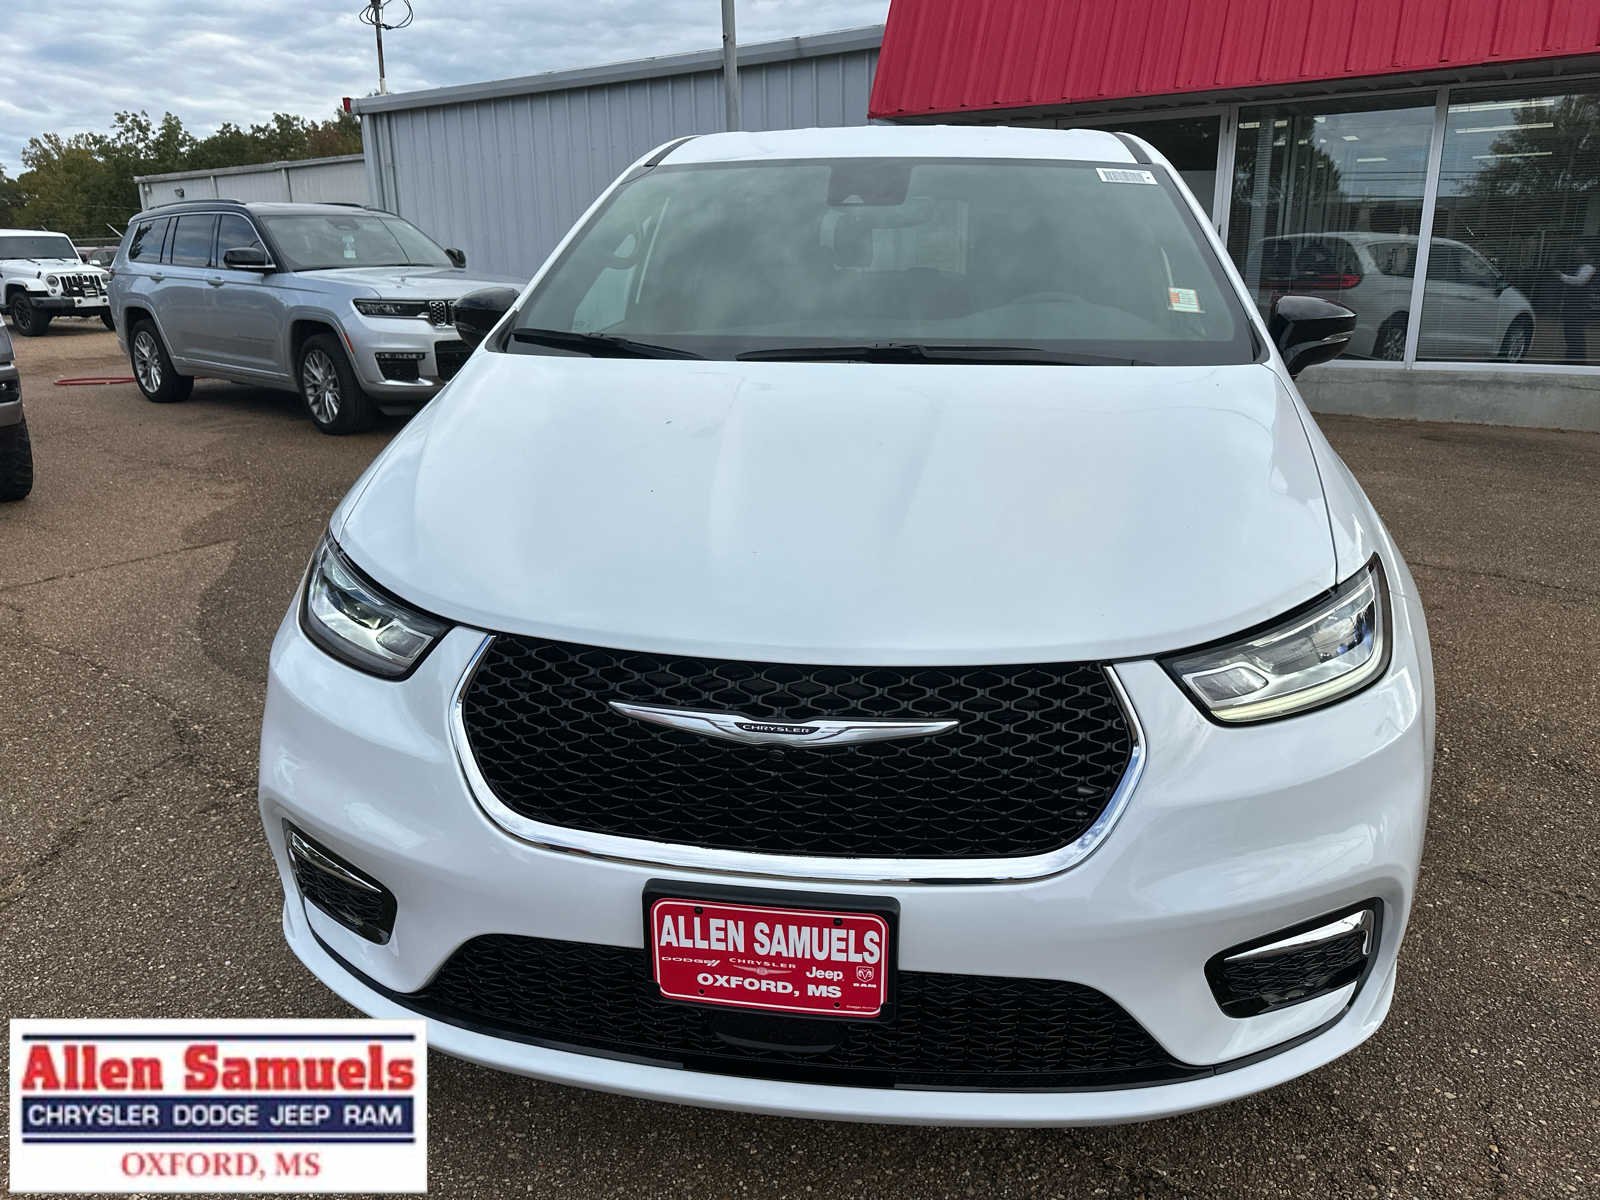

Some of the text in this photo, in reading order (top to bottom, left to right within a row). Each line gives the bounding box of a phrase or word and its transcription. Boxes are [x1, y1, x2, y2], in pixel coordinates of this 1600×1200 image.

[742, 723, 811, 734] CHRYSLER
[660, 914, 881, 964] ALLEN SAMUELS
[661, 956, 714, 966] DODGE
[728, 957, 797, 969] CHRYSLER
[806, 966, 844, 981] Jeep
[696, 972, 842, 998] OXFORD, MS
